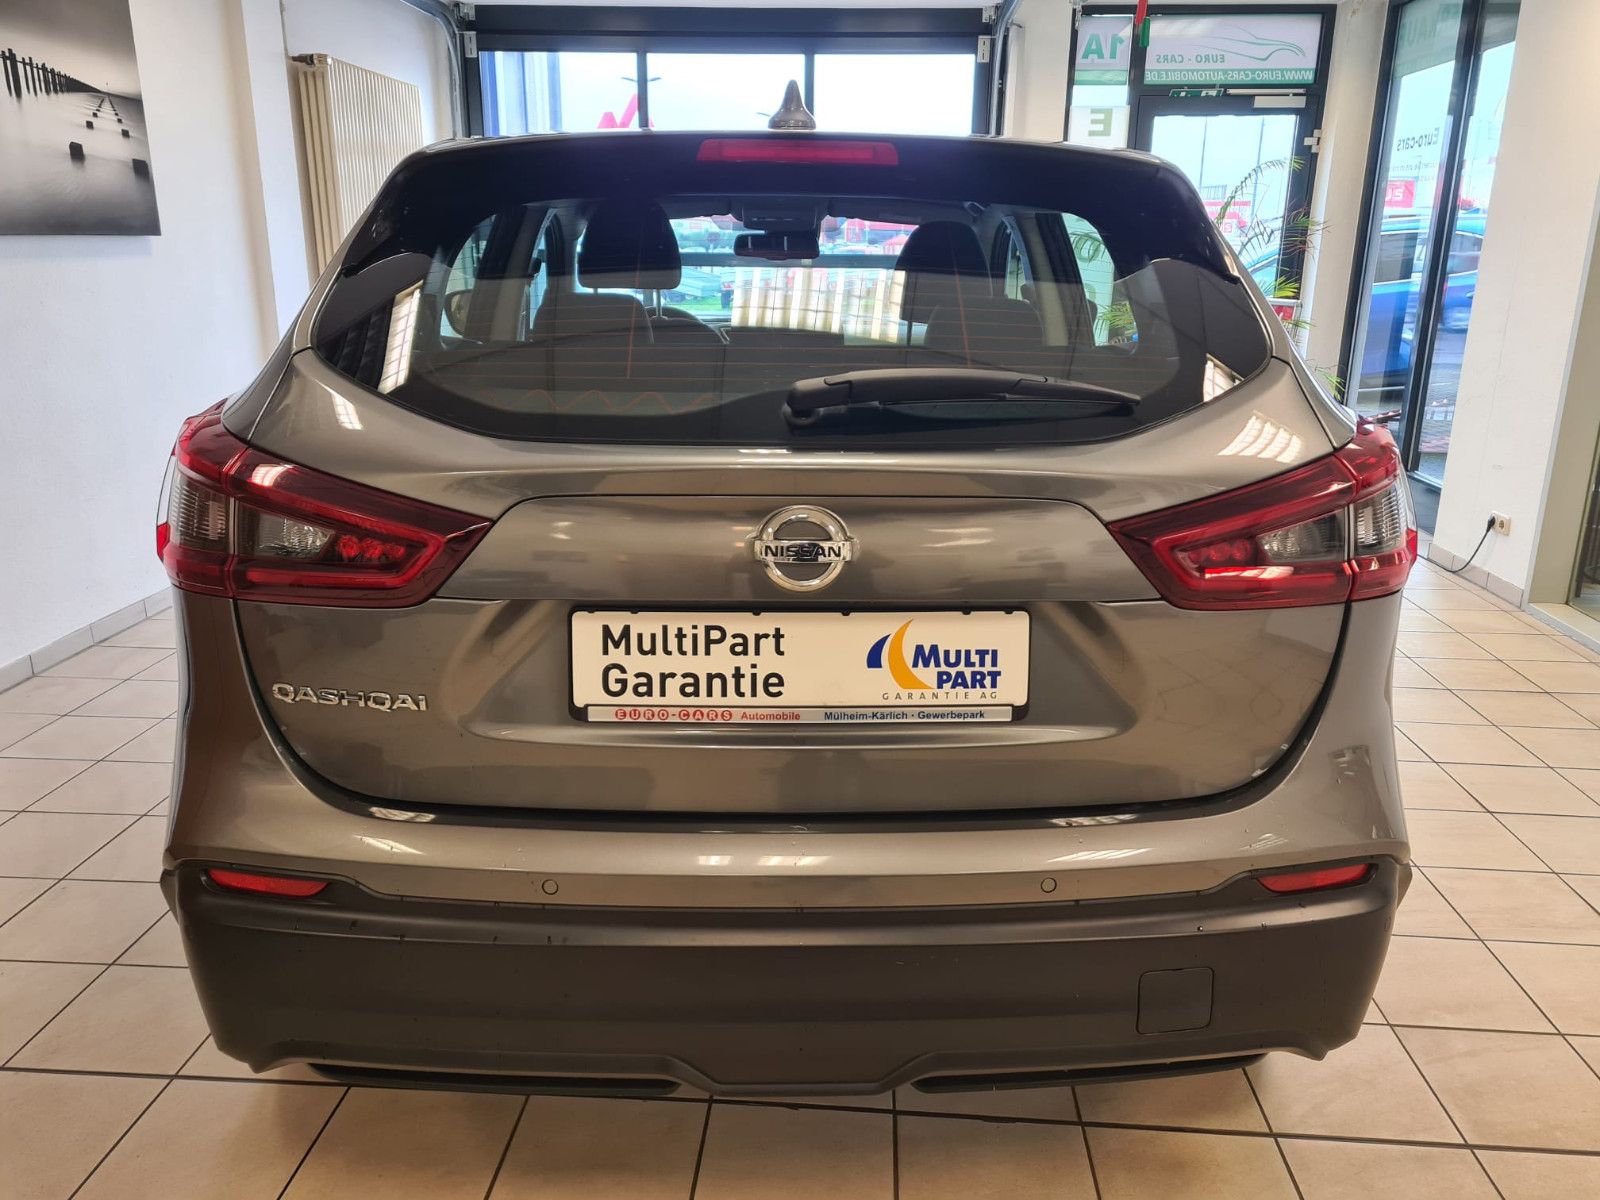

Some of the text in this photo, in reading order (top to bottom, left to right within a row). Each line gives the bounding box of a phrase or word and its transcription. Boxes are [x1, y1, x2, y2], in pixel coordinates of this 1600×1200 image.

[764, 545, 842, 558] NISSAN
[601, 624, 785, 656] MultiPart
[912, 644, 998, 668] MULTI
[602, 663, 785, 698] Garantie
[937, 671, 1001, 689] PART
[271, 683, 428, 712] QASHQAI
[882, 692, 970, 700] GARANTIE
[615, 708, 733, 721] EURO-CARS
[741, 711, 800, 720] Automobile
[824, 711, 908, 720] Mülheim-Kärlich
[917, 711, 985, 721] Gewerbepark
